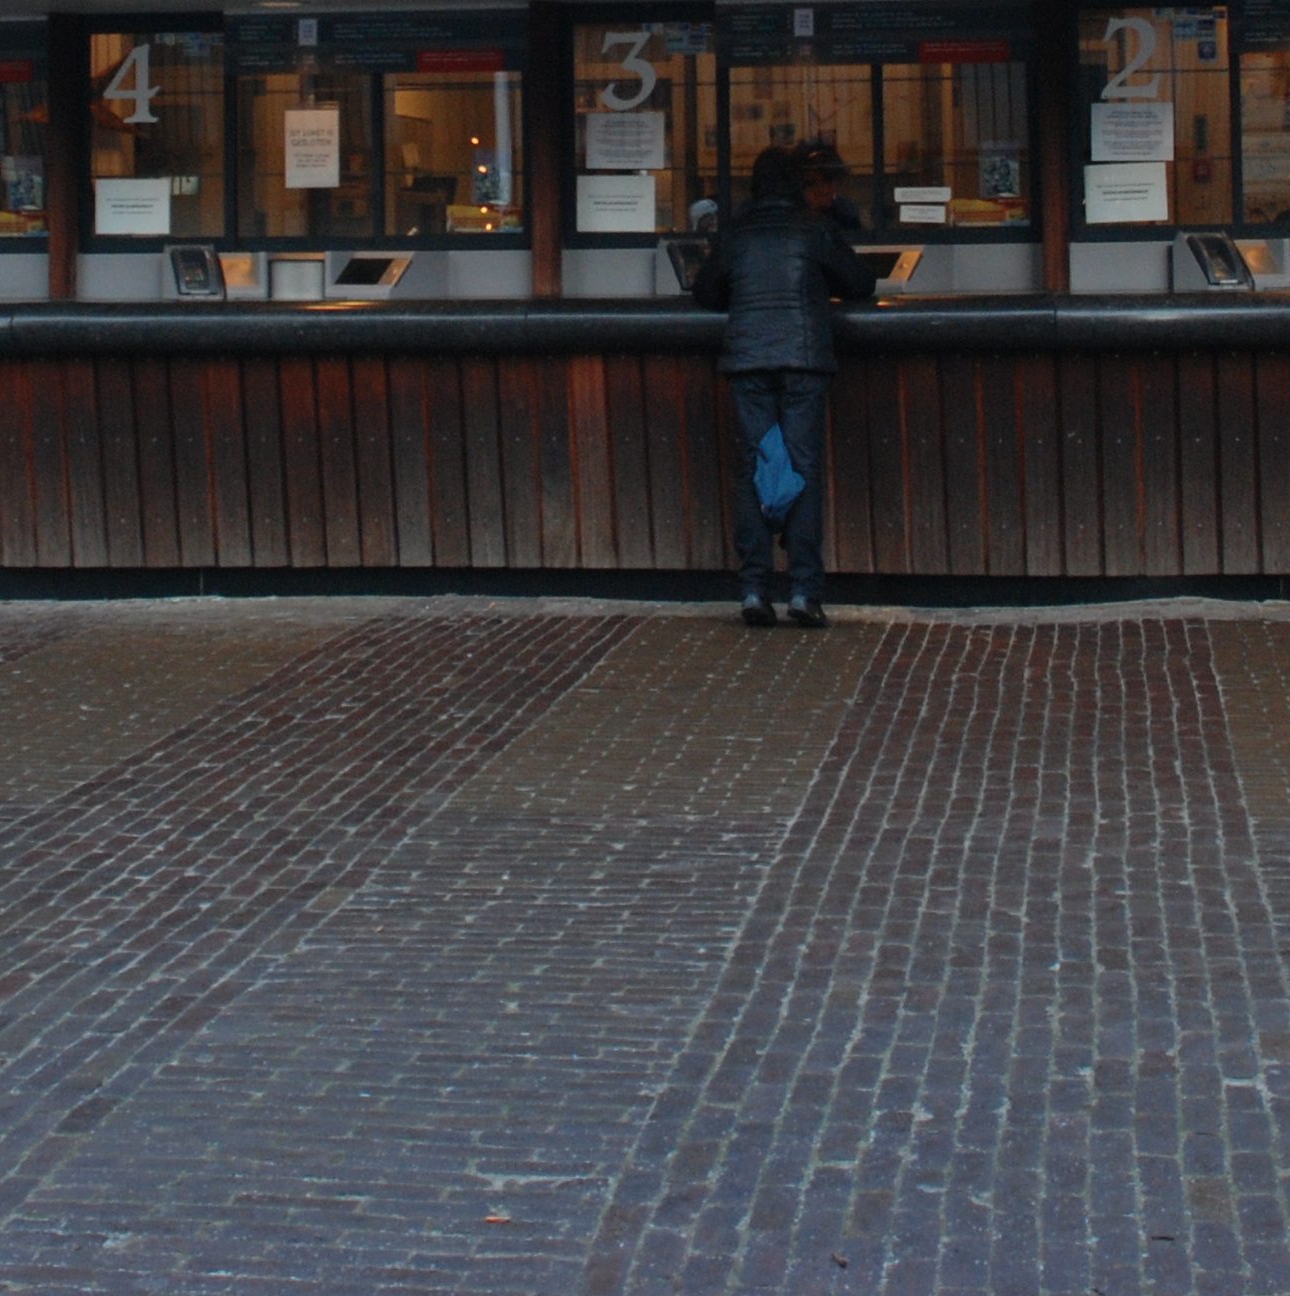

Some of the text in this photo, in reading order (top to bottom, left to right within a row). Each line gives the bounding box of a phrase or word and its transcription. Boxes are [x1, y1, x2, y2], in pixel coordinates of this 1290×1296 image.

[102, 43, 162, 124] 4
[600, 31, 658, 112] 3
[1100, 17, 1161, 100] 2
